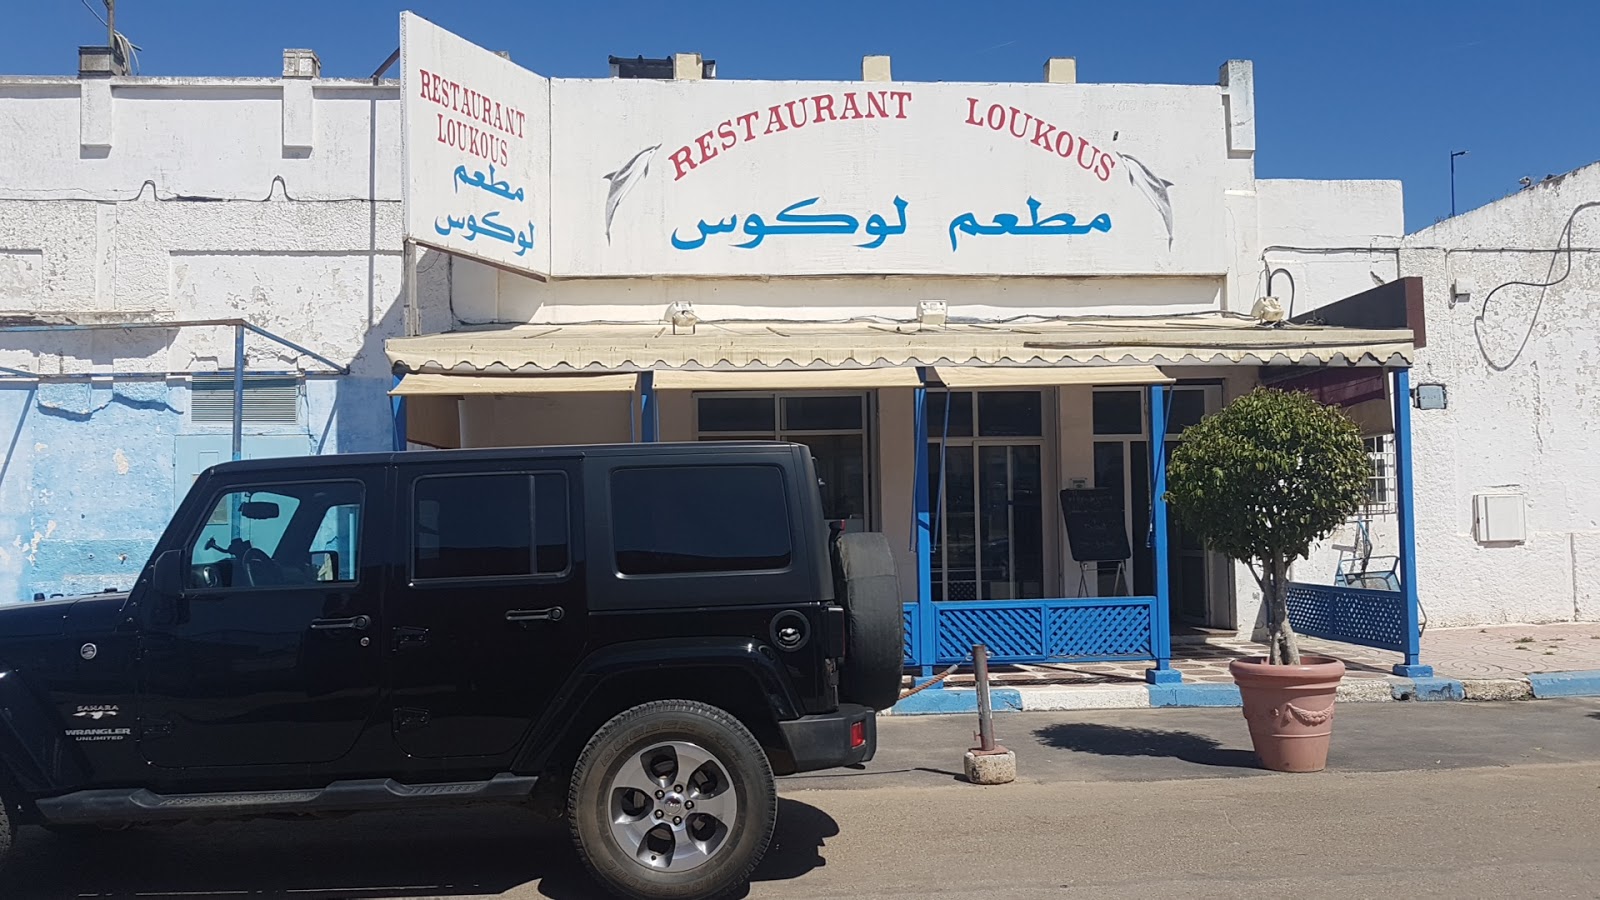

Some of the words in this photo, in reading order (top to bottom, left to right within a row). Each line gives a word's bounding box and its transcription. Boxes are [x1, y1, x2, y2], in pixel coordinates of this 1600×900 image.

[419, 69, 526, 139] RESTAURANT
[437, 113, 508, 167] LOUKOUS
[667, 90, 913, 181] RESTAURANT
[964, 97, 1116, 182] LOUKOUS
[453, 162, 525, 202] مطعم
[434, 211, 535, 257] لوكوس
[671, 195, 909, 251] لوكوس
[948, 195, 1113, 252] مطعم
[64, 727, 131, 736] WRANGLER
[76, 704, 119, 712] SAHARA
